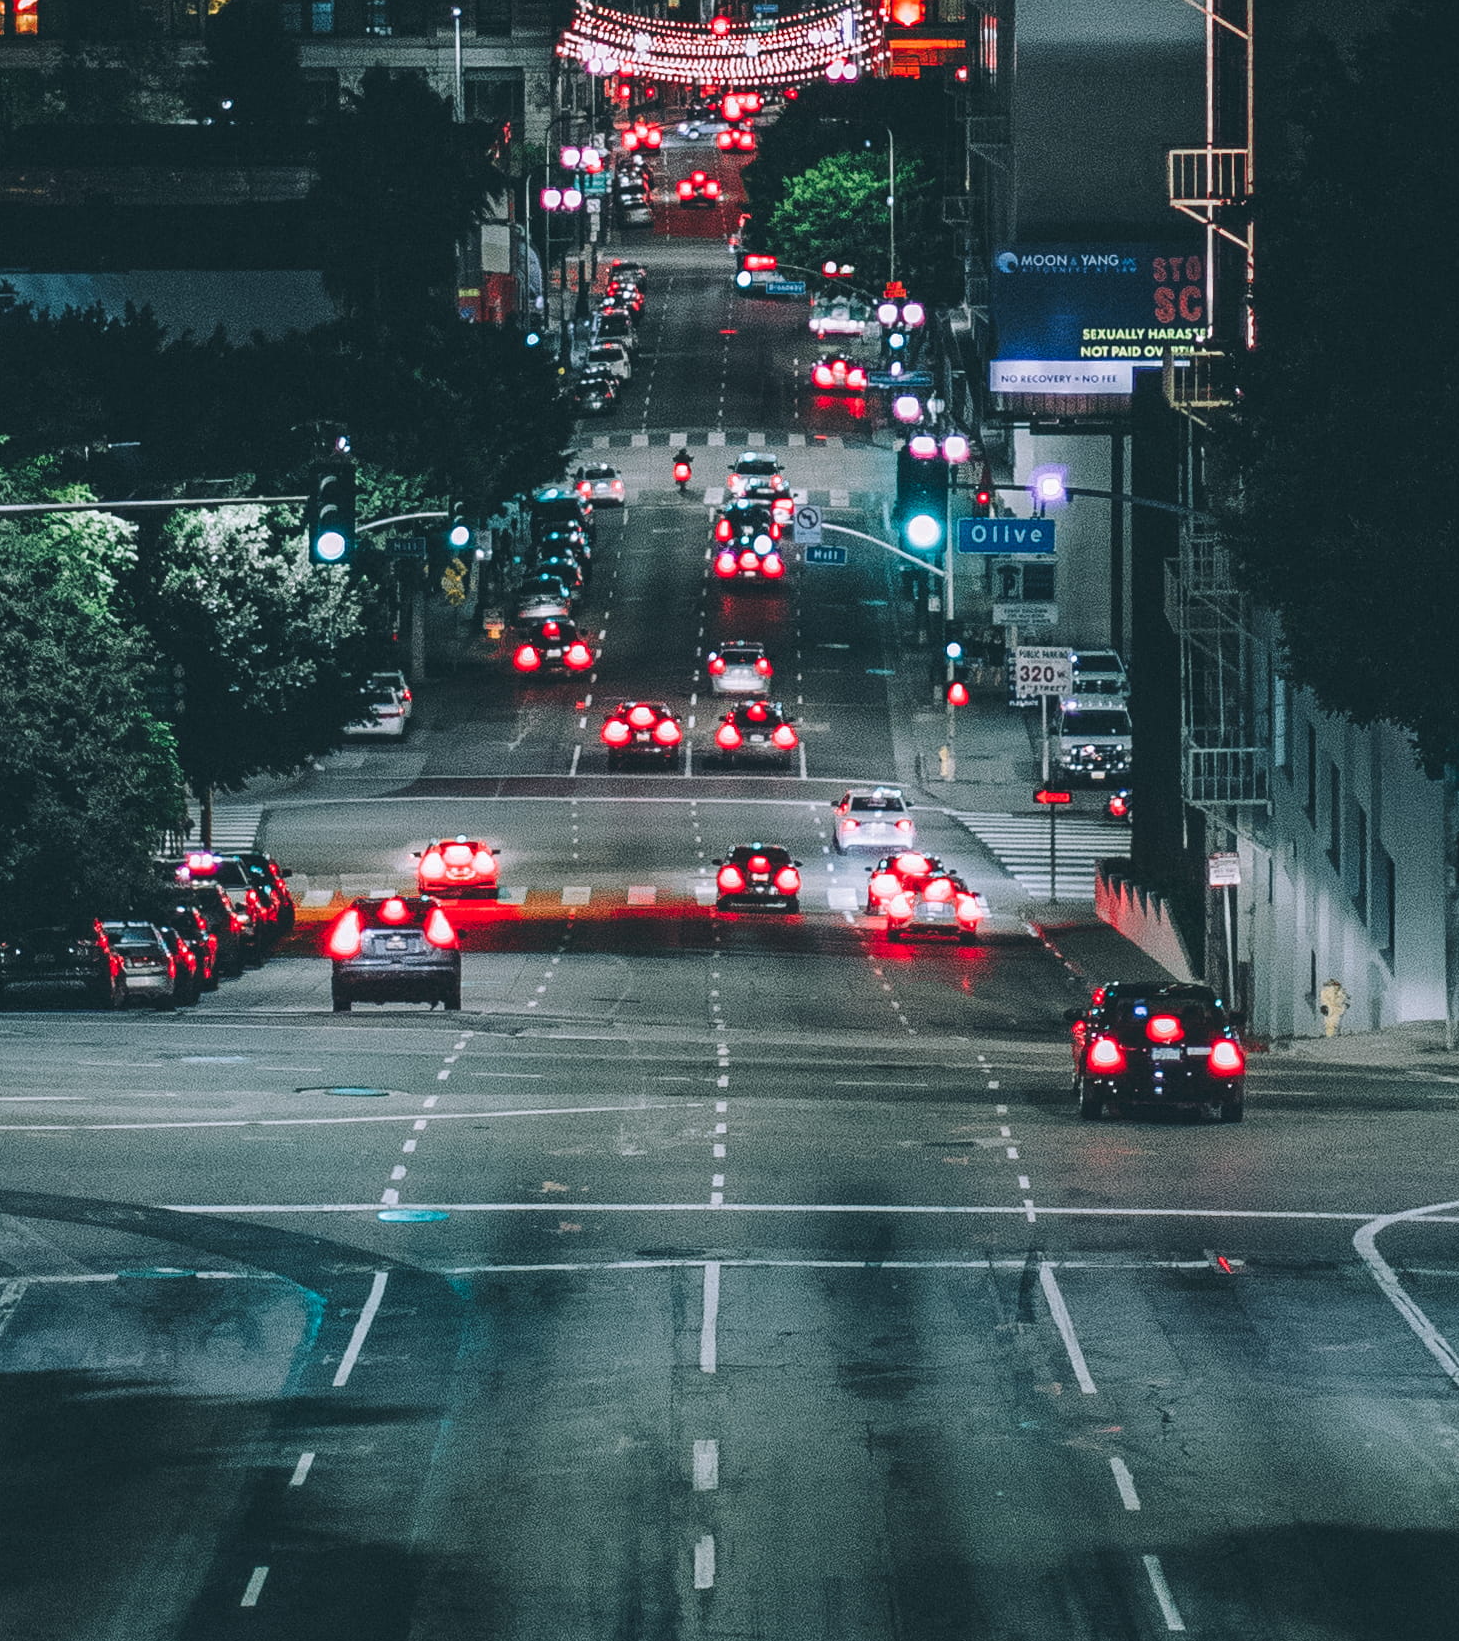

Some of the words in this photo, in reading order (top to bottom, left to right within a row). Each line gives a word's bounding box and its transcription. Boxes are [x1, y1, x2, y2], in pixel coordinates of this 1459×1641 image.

[1020, 254, 1068, 266] MOON
[1080, 254, 1120, 266] YANG
[1082, 328, 1145, 340] SEXUALLY
[1080, 345, 1109, 357] NOT
[1111, 345, 1142, 357] PAID
[1000, 374, 1018, 383] NO
[1020, 374, 1072, 383] RECOVERY
[1082, 374, 1100, 383] NO
[1102, 374, 1117, 383] FEE
[971, 524, 1044, 543] Olive
[813, 548, 839, 560] Hill
[1020, 665, 1055, 683] 320
[1033, 684, 1067, 692] STREET
